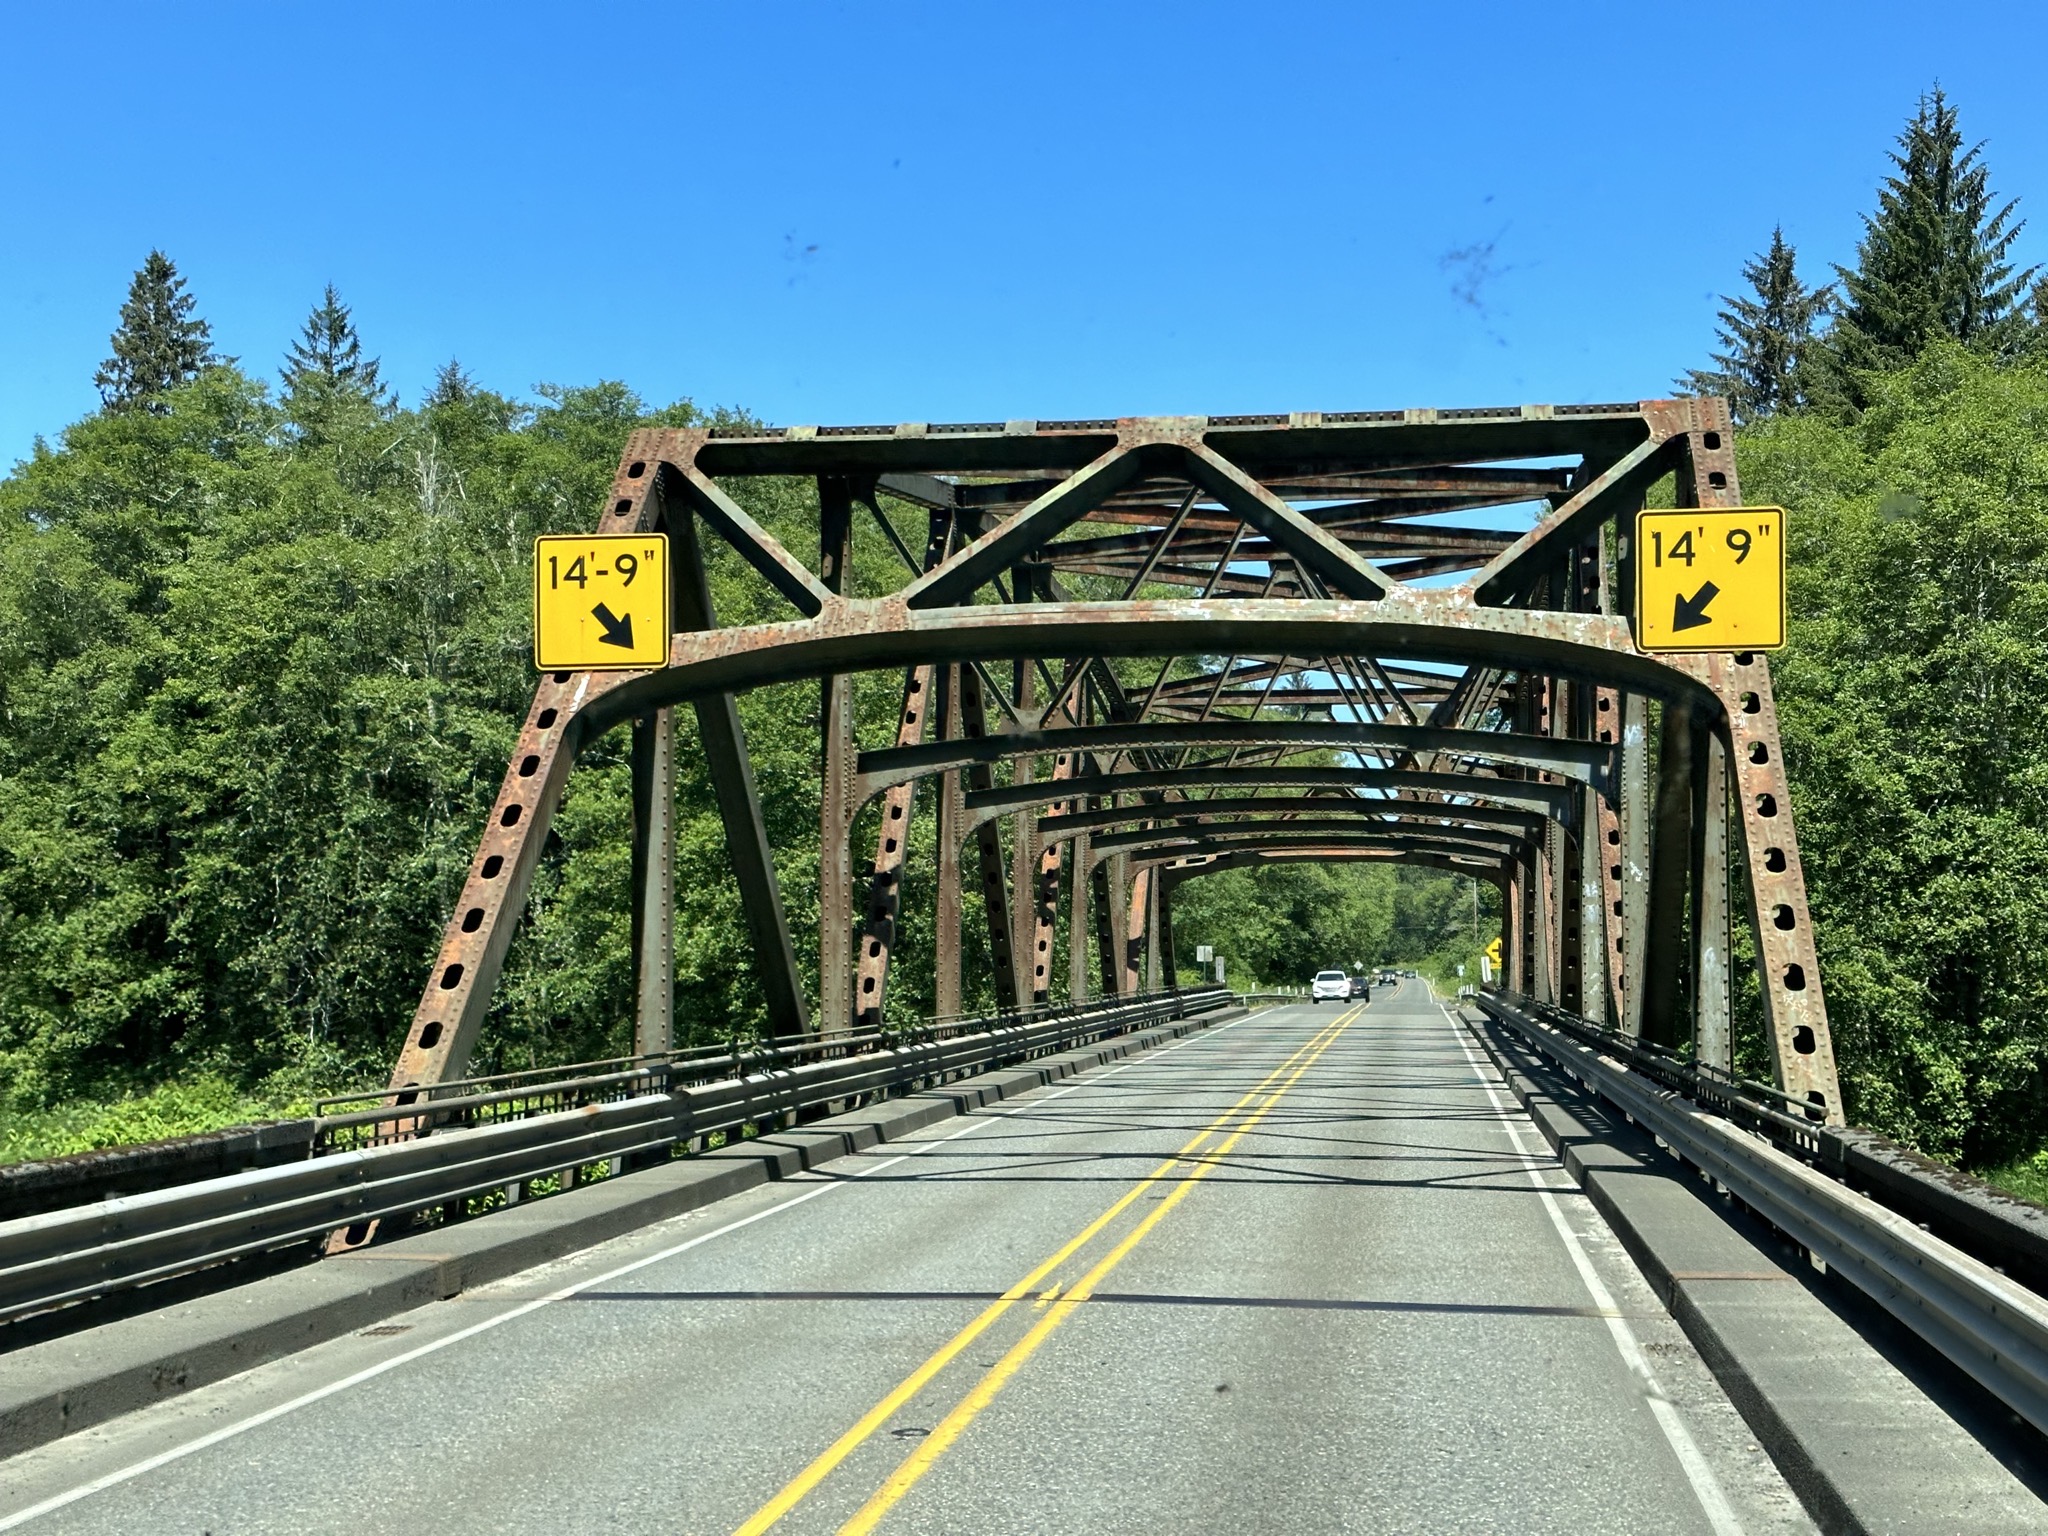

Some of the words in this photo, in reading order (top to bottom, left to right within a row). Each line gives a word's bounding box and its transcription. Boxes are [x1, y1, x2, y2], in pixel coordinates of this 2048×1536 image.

[1651, 526, 1704, 568] 14'
[1726, 524, 1770, 565] 9"
[548, 550, 655, 590] 14'-9"
